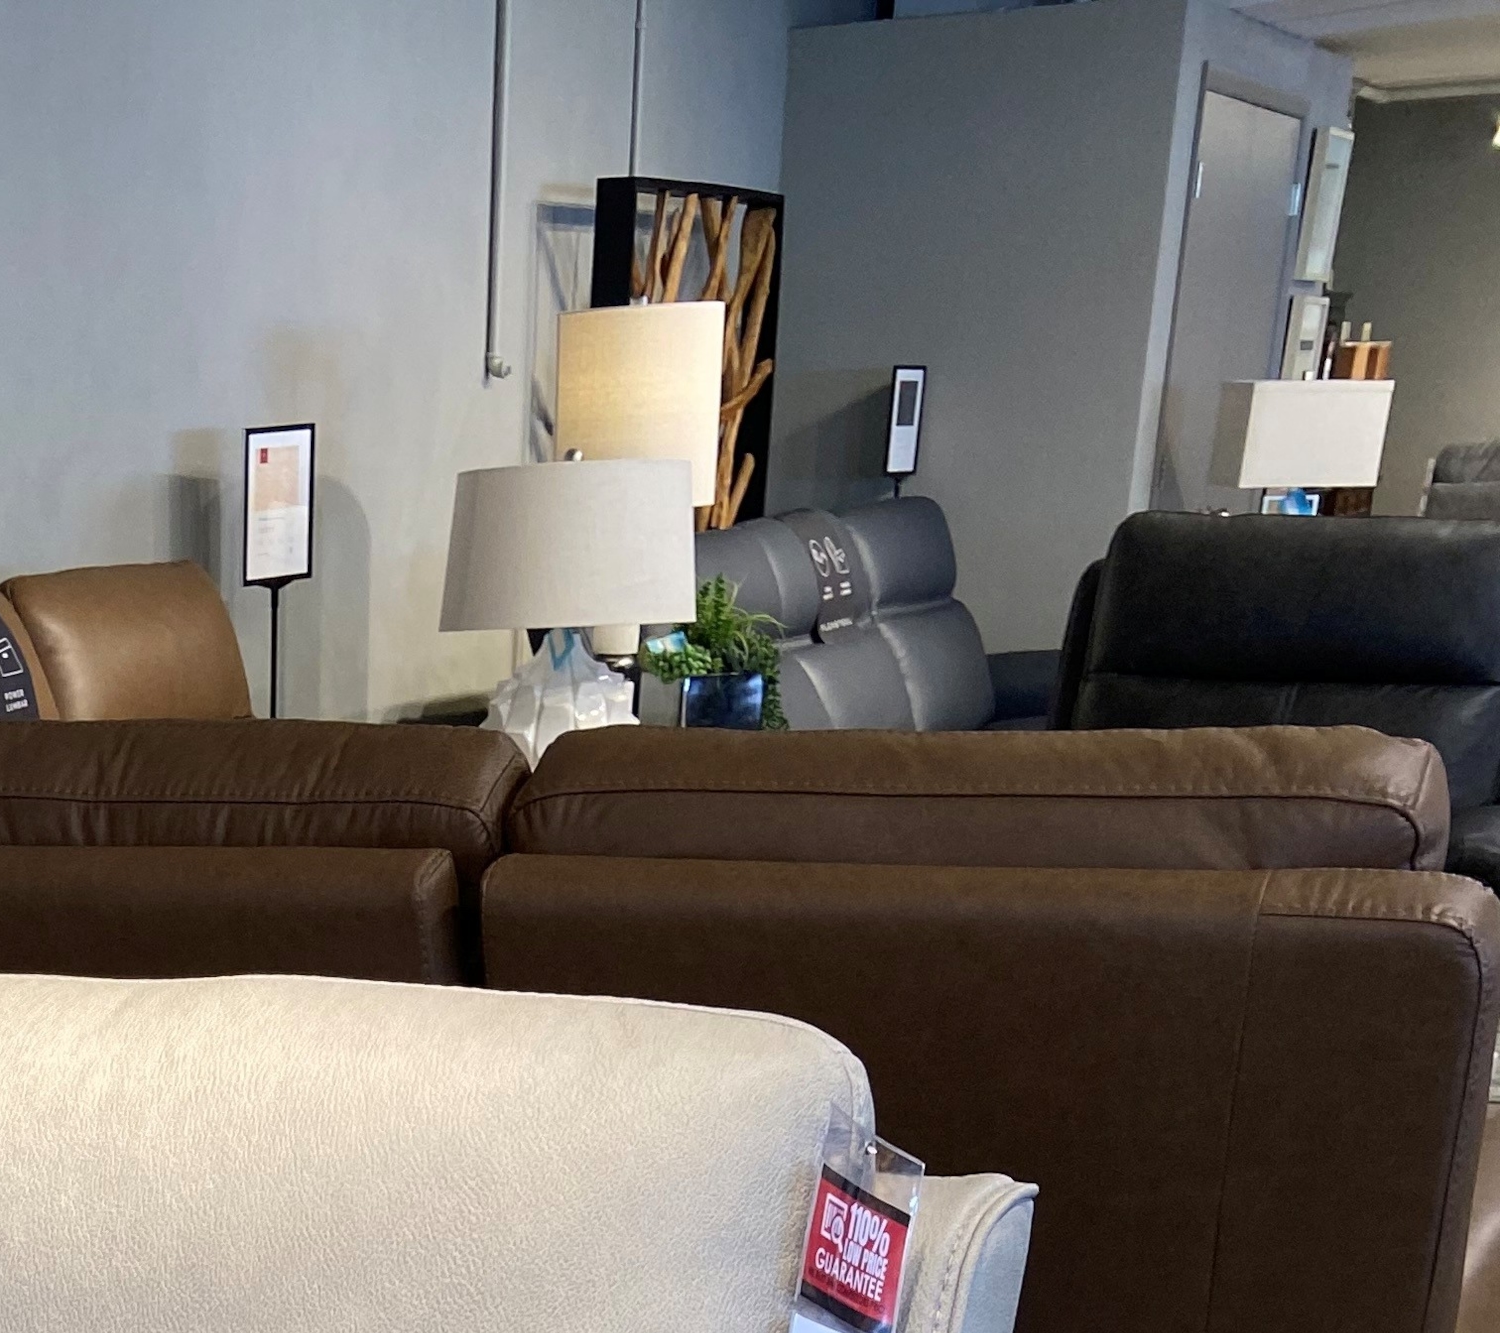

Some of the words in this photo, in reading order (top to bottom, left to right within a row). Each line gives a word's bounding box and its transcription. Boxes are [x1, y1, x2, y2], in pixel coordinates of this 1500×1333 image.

[847, 1201, 891, 1257] 110%
[815, 1247, 884, 1302] GUARANTEE
[842, 1238, 862, 1267] LOW
[860, 1249, 889, 1281] PRICE
